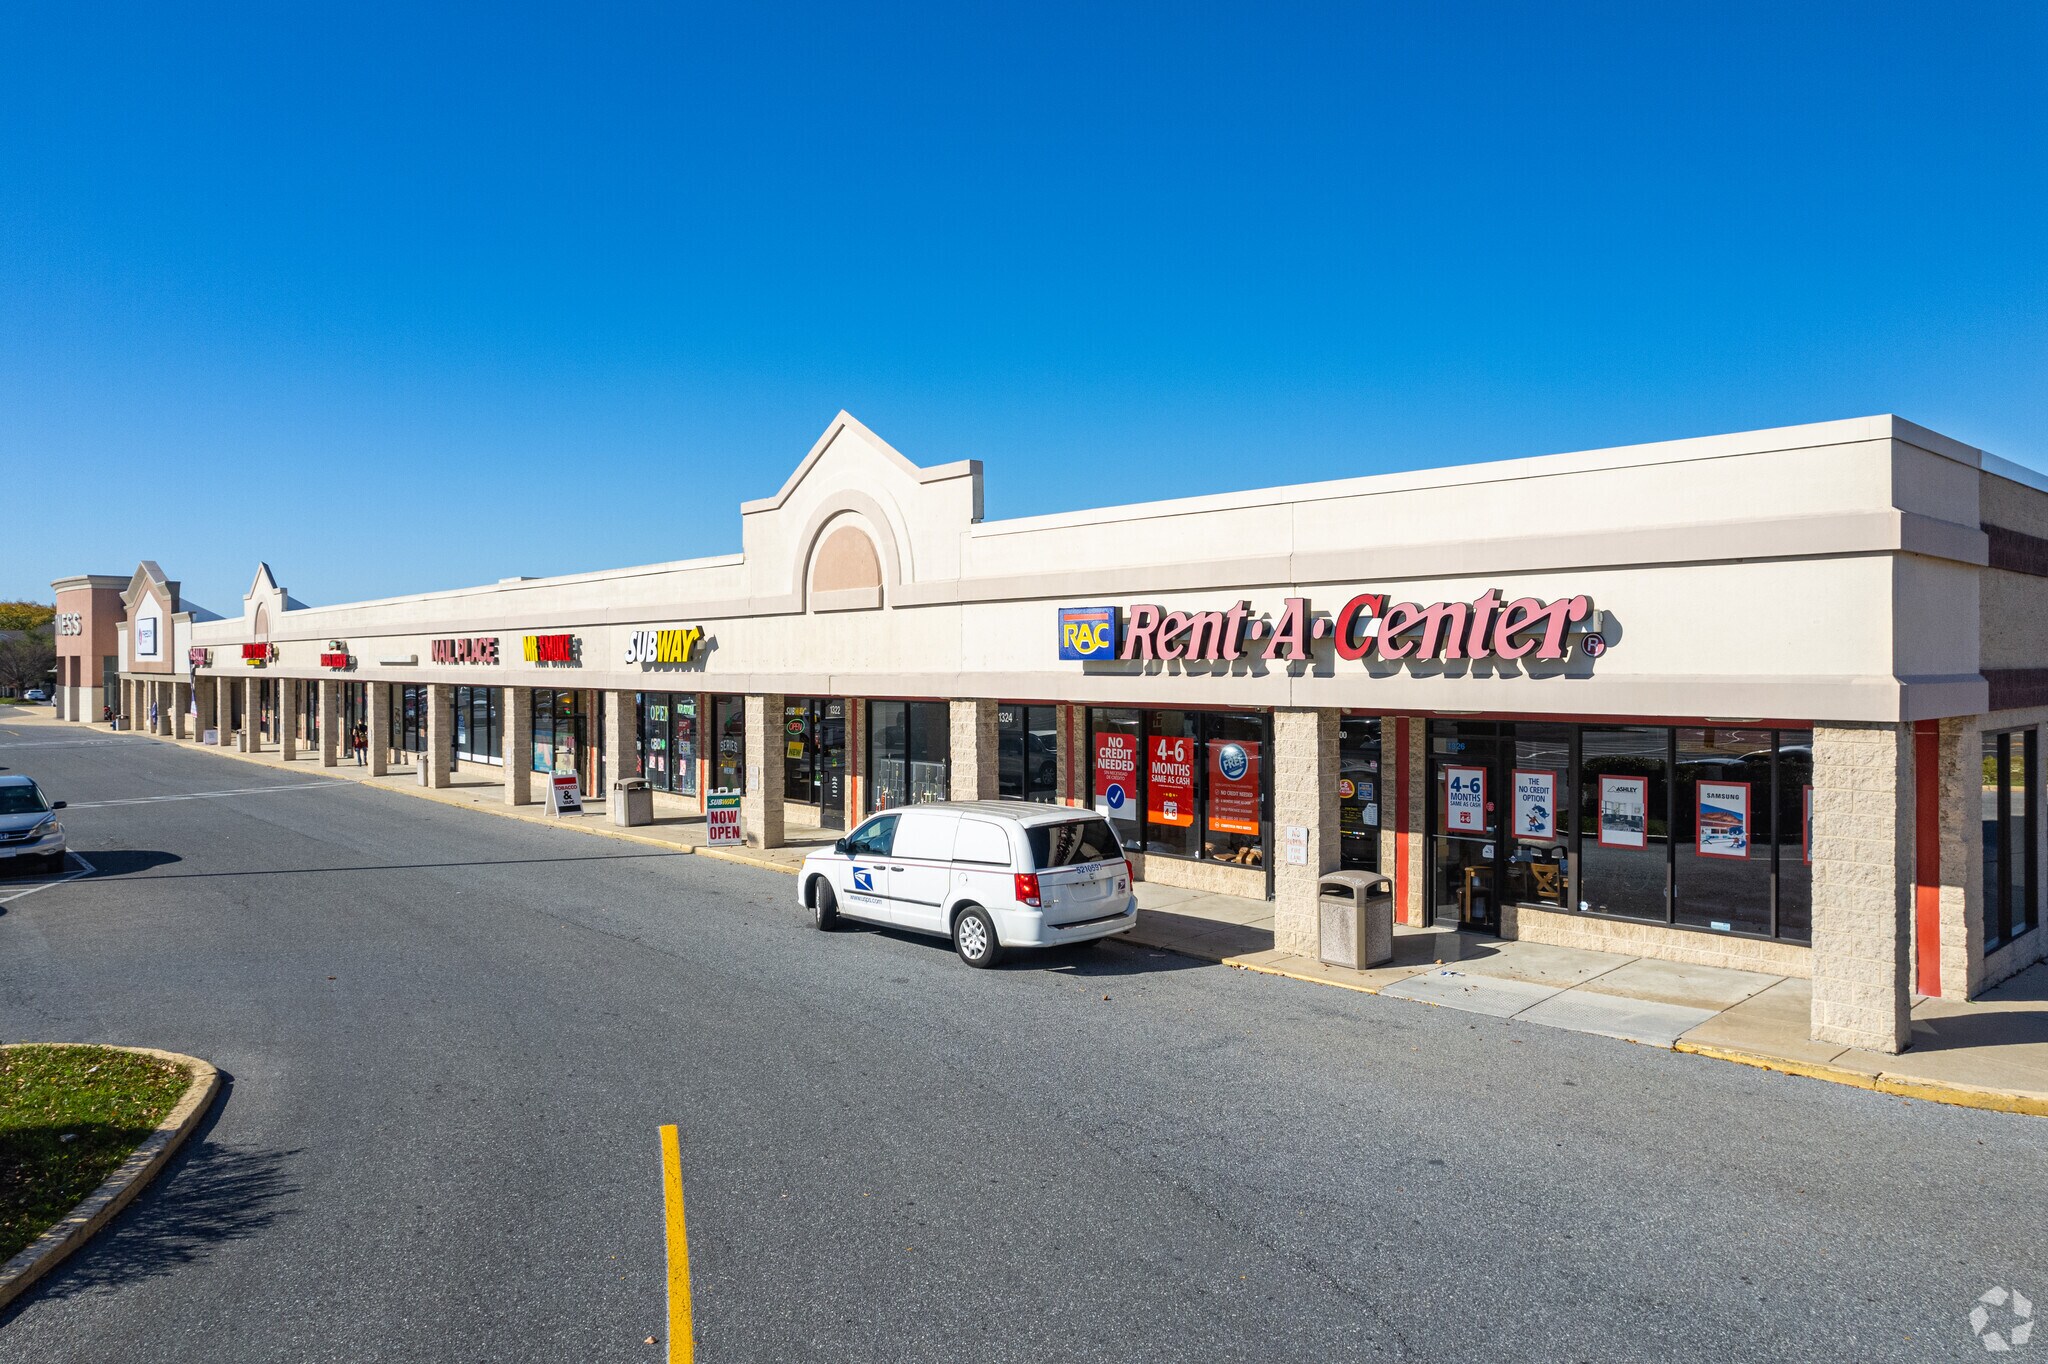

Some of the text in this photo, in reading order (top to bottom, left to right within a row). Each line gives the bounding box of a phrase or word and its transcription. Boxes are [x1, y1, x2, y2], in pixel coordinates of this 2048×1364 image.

[624, 626, 700, 663] SUBWAY
[1063, 623, 1109, 655] RAC
[431, 637, 495, 662] NAIL PLACE
[523, 634, 571, 662] MR SMOKE
[650, 705, 669, 721] OPEN
[829, 705, 841, 715] 1322
[998, 712, 1013, 723] 1324
[788, 722, 803, 732] OPEN
[1108, 736, 1124, 749] NO
[1099, 747, 1133, 760] CREDIT
[1157, 739, 1185, 762] 4-6
[1097, 758, 1135, 772] NEEDED
[1151, 761, 1191, 777] MONTHS
[1223, 758, 1245, 771] FREE
[1151, 774, 1191, 786] SAME AS CASH
[1450, 776, 1481, 794] 4-6
[1528, 777, 1540, 786] THE
[563, 790, 572, 800] &
[1518, 785, 1550, 795] NO CREDIT
[1706, 792, 1740, 800] SAMSUNG
[709, 797, 738, 806] SUBWAY
[1450, 792, 1481, 802] MONTHS
[1522, 793, 1546, 803] OPTION
[710, 810, 737, 824] NOW
[1164, 807, 1177, 818] 4-6
[1460, 815, 1471, 823] 4-6
[710, 825, 740, 840] OPEN
